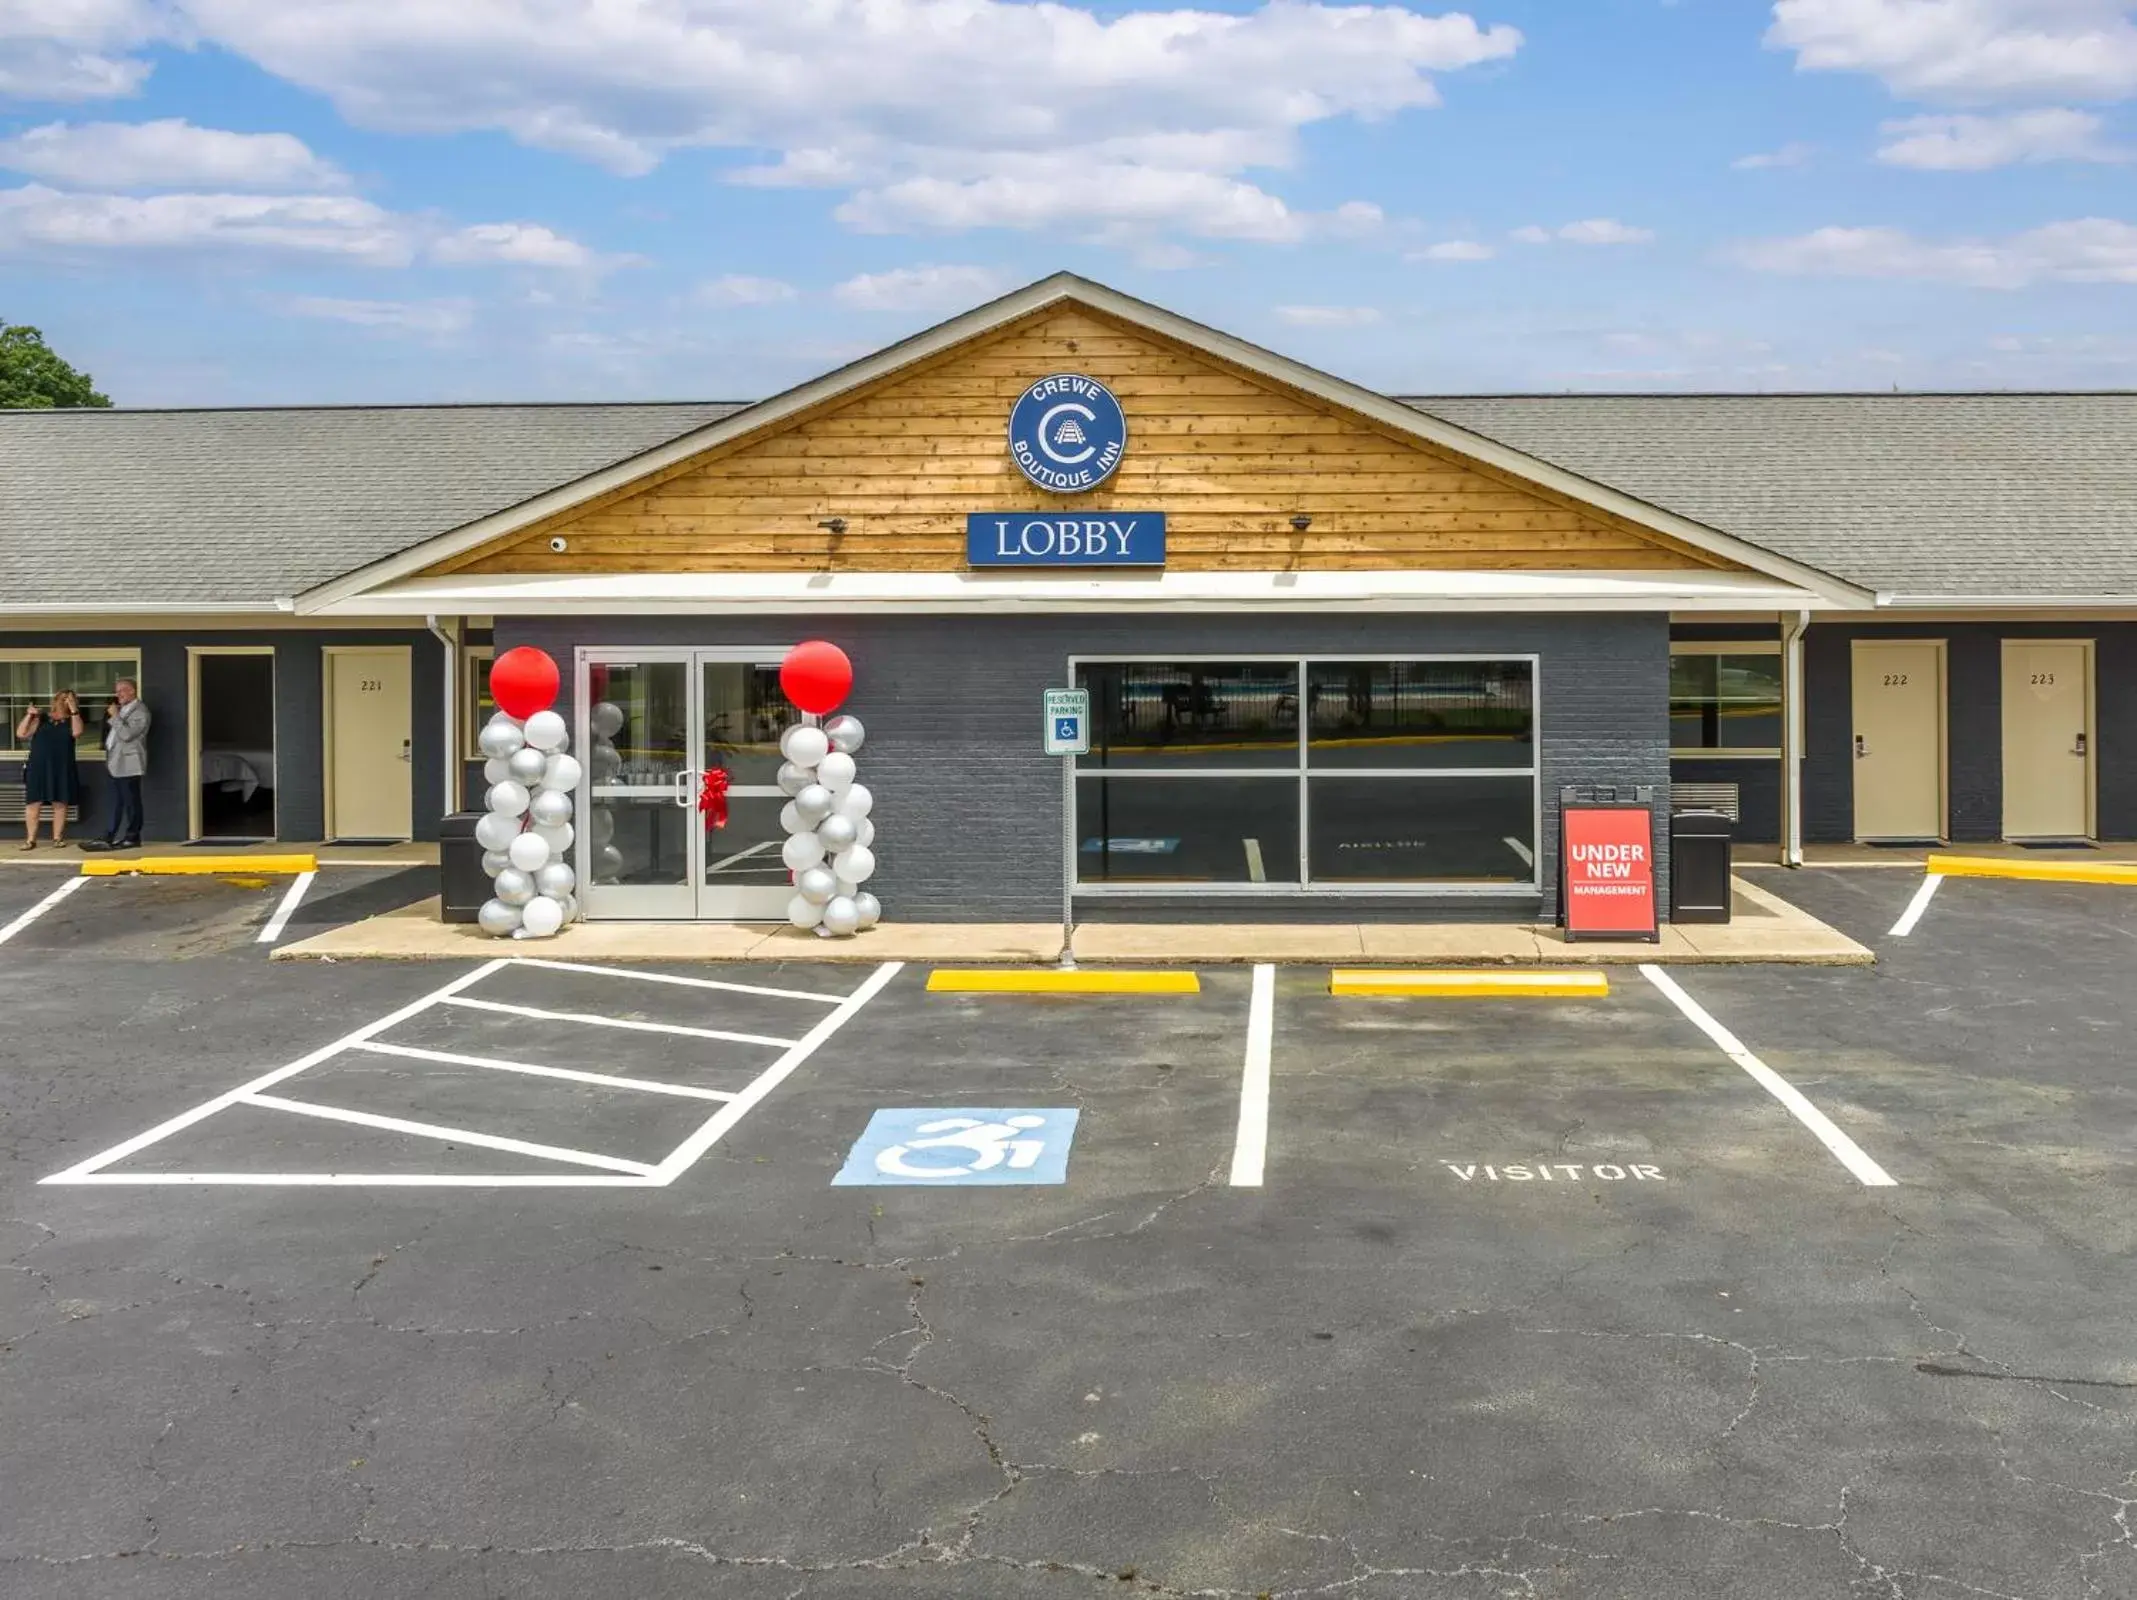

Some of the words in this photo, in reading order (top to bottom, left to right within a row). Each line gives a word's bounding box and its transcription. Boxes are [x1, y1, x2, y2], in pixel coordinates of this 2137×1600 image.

[1032, 378, 1101, 401] CREWE
[1014, 440, 1093, 487] BOUTIQUE
[1096, 441, 1121, 471] INN
[994, 521, 1137, 555] LOBBY
[361, 680, 382, 691] 221
[1883, 674, 1908, 686] 222
[2030, 674, 2054, 685] 223
[1047, 695, 1085, 704] RESERVED
[1050, 706, 1083, 714] PARKING
[1571, 844, 1645, 862] UNDER
[1587, 862, 1631, 878] NEW
[1573, 886, 1647, 896] MANAGEMENT
[1446, 1163, 1667, 1181] VISITOR
